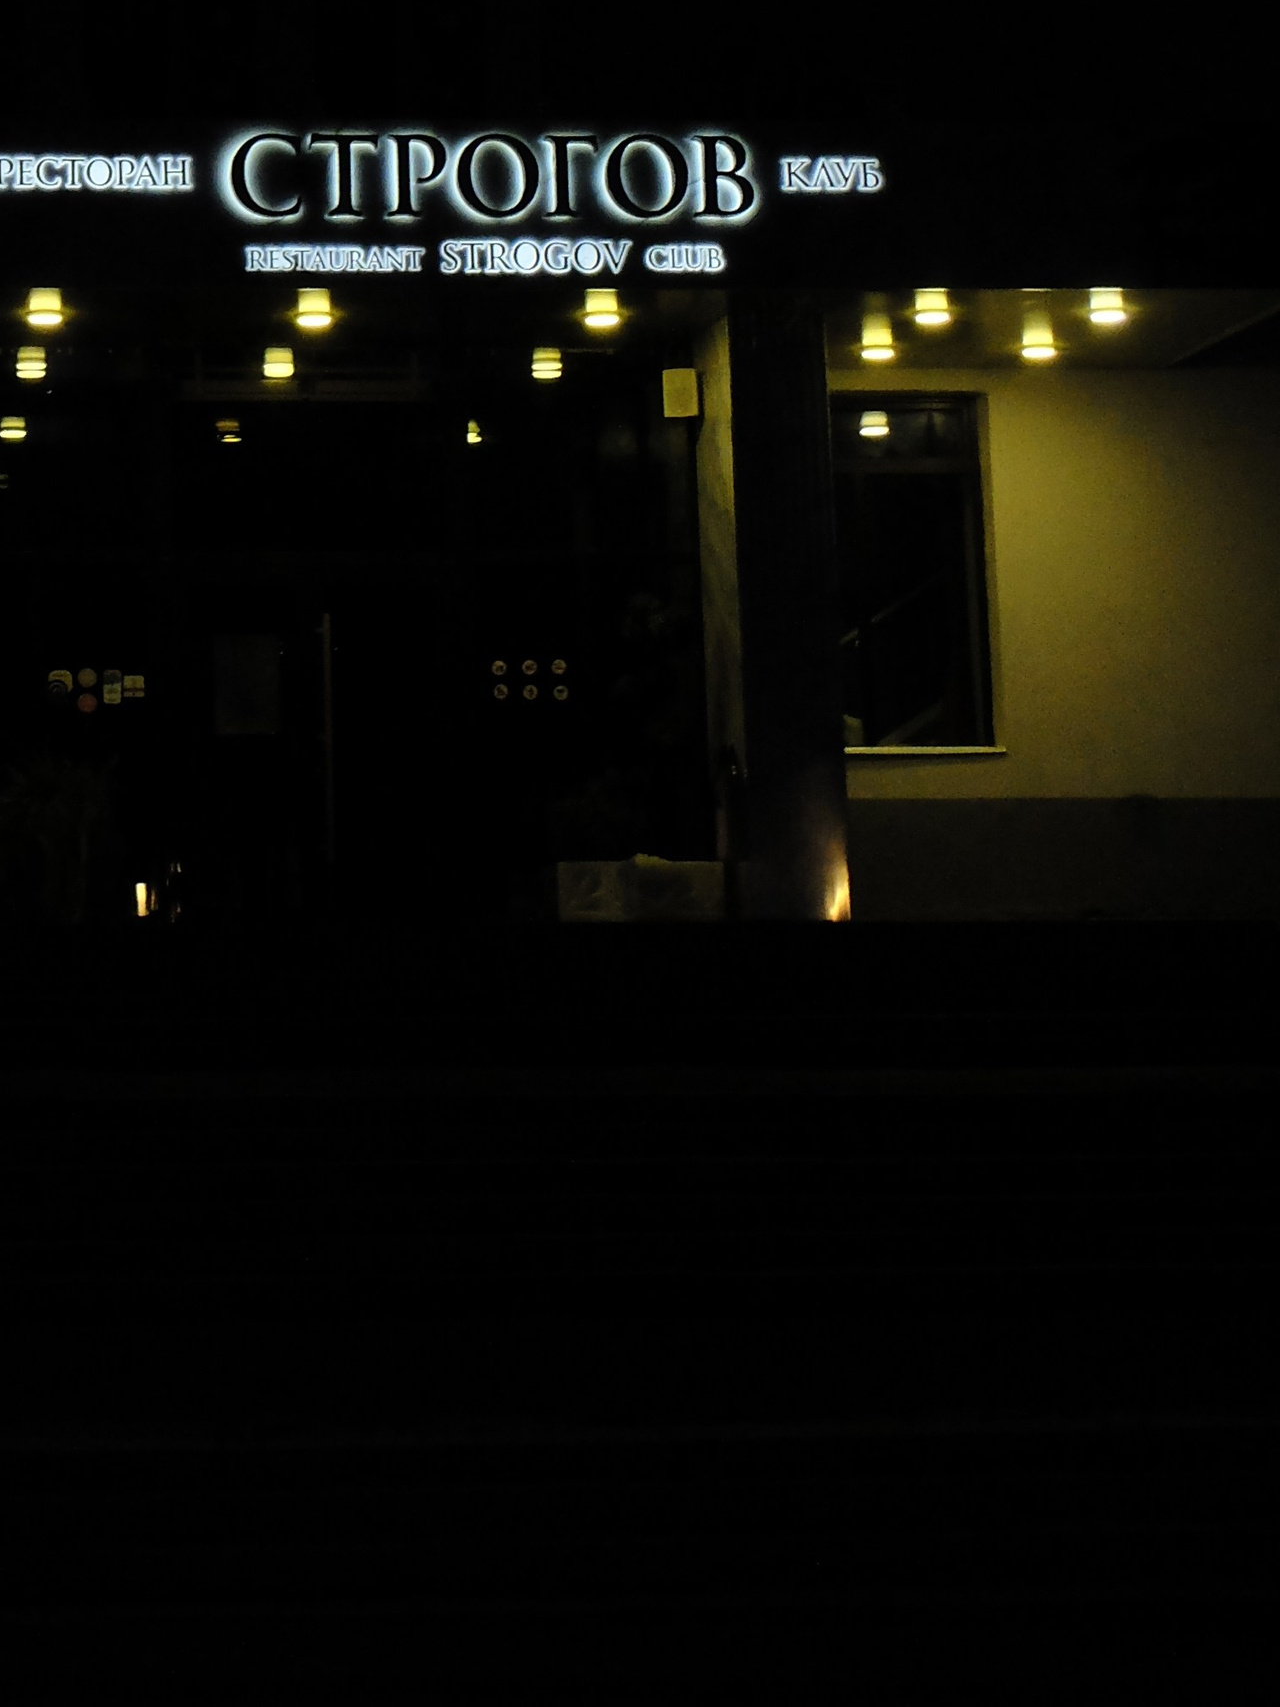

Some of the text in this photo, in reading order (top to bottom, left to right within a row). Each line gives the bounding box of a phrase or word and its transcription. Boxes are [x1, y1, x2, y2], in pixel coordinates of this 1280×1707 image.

[228, 129, 758, 222] СТРОГОВ
[782, 157, 884, 191] КЛУБ
[245, 239, 725, 274] RESTAURANT STROGOV CLUB
